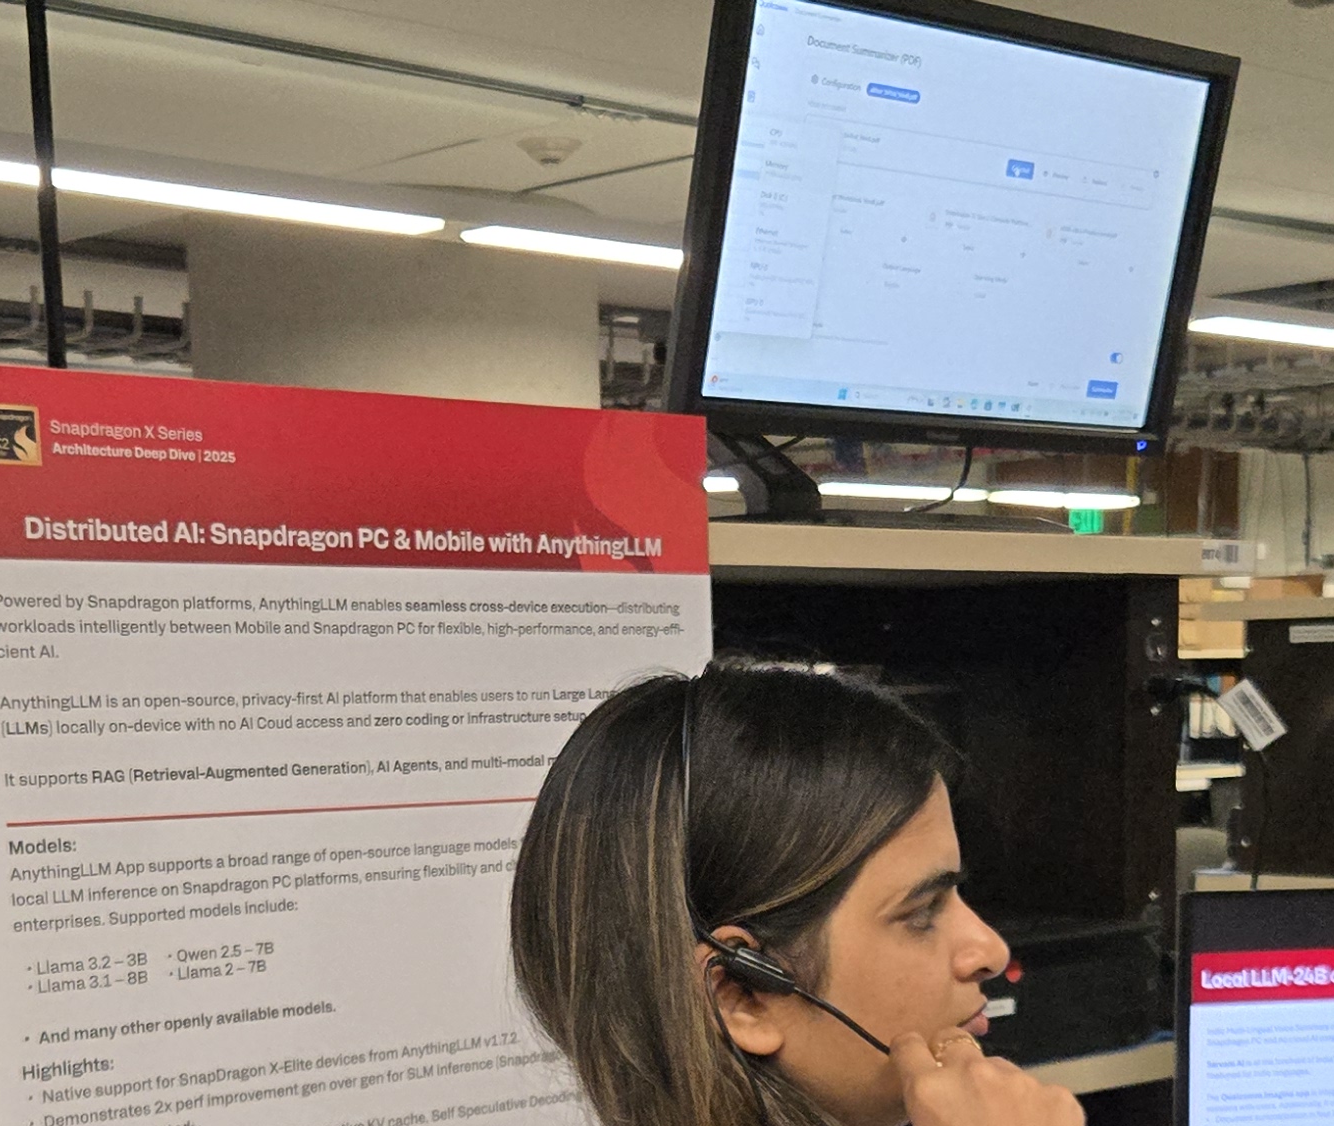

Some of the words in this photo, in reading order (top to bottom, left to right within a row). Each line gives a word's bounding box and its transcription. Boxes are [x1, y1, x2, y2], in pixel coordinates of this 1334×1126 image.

[50, 419, 141, 440] Snapdragon
[144, 425, 154, 439] X
[157, 425, 202, 441] Series
[52, 442, 132, 457] Architecture
[134, 446, 166, 461] Deep
[168, 448, 195, 461] Dive
[203, 450, 236, 463] 2025
[24, 516, 168, 542] Distributed
[174, 521, 204, 543] AI:
[210, 522, 352, 551] Snapdragon
[357, 527, 388, 549] PC
[394, 528, 410, 549] &
[414, 530, 484, 552] Mobile
[488, 532, 531, 553] with
[536, 534, 661, 560] AnythingLLM
[65, 594, 83, 610] by
[87, 594, 179, 612] Snapdragon
[183, 596, 255, 611] platforms,
[259, 597, 347, 613] AnythingLLM
[351, 598, 401, 611] enables
[405, 600, 466, 612] seamless
[469, 600, 547, 612] cross-device
[79, 619, 165, 636] intelligently
[169, 620, 231, 633] between
[235, 621, 280, 634] Mobile
[284, 621, 309, 634] and
[313, 621, 393, 637] Snapdragon
[397, 622, 415, 634] PC
[417, 622, 435, 634] for
[437, 621, 484, 636] flexible,
[487, 622, 595, 637] high-performance,
[597, 623, 619, 635] and
[39, 644, 58, 658] AI.
[0, 695, 101, 712] AnythingLLM
[105, 694, 117, 708] is
[122, 697, 139, 707] an
[144, 695, 238, 709] open-source,
[242, 691, 323, 708] privacy-first
[326, 691, 338, 704] AI
[343, 691, 397, 707] platform
[400, 690, 426, 703] that
[429, 690, 477, 702] enables
[481, 691, 513, 701] users
[516, 690, 528, 701] to
[531, 691, 549, 700] run
[552, 689, 585, 702] Large
[1, 720, 52, 737] (LLMs)
[56, 719, 105, 736] locally
[109, 719, 181, 732] on-device
[185, 717, 214, 731] with
[219, 720, 235, 730] no
[239, 717, 253, 729] AI
[257, 715, 292, 729] Coud
[296, 717, 343, 728] access
[347, 714, 371, 727] and
[374, 716, 402, 726] zero
[405, 713, 449, 727] coding
[451, 715, 464, 724] or
[467, 711, 550, 723] infrastructure
[4, 773, 14, 786] It
[19, 772, 87, 788] supports
[92, 770, 124, 783] RAG
[129, 763, 287, 783] (Retrieval-Augmented
[291, 761, 373, 776] Generation),
[376, 760, 389, 772] AI
[393, 760, 441, 774] Agents,
[445, 757, 467, 770] and
[471, 755, 544, 769] multi-modal
[9, 838, 76, 854] Models:
[10, 862, 111, 883] AnythingLLM
[115, 861, 144, 876] App
[148, 857, 212, 874] supports
[216, 858, 224, 868] a
[228, 852, 268, 867] broad
[272, 852, 310, 866] range
[313, 848, 326, 862] of
[329, 846, 410, 863] open-source
[413, 842, 470, 857] language
[474, 837, 518, 851] models
[13, 914, 104, 932] enterprises.
[109, 906, 185, 926] Supported
[189, 902, 241, 918] models
[245, 898, 297, 914] include:
[37, 960, 84, 975] Llama
[88, 955, 110, 970] 3.2
[126, 952, 147, 966] 3B
[177, 949, 216, 963] Qwen
[221, 944, 241, 958] 2.5
[255, 941, 274, 954] 7B
[178, 966, 222, 980] Llama
[225, 962, 233, 976] 2
[248, 959, 266, 972] 7B
[1201, 968, 1249, 989] Local
[1250, 966, 1331, 987] LLM-24B
[38, 979, 85, 993] Llama
[89, 974, 111, 988] 3.1
[127, 970, 147, 985] 8B
[39, 1027, 69, 1044] And
[74, 1026, 117, 1040] many
[120, 1020, 160, 1035] other
[164, 1013, 212, 1032] openly
[216, 1006, 278, 1025] available
[282, 1001, 335, 1017] models.
[22, 1058, 113, 1081] Highlights:
